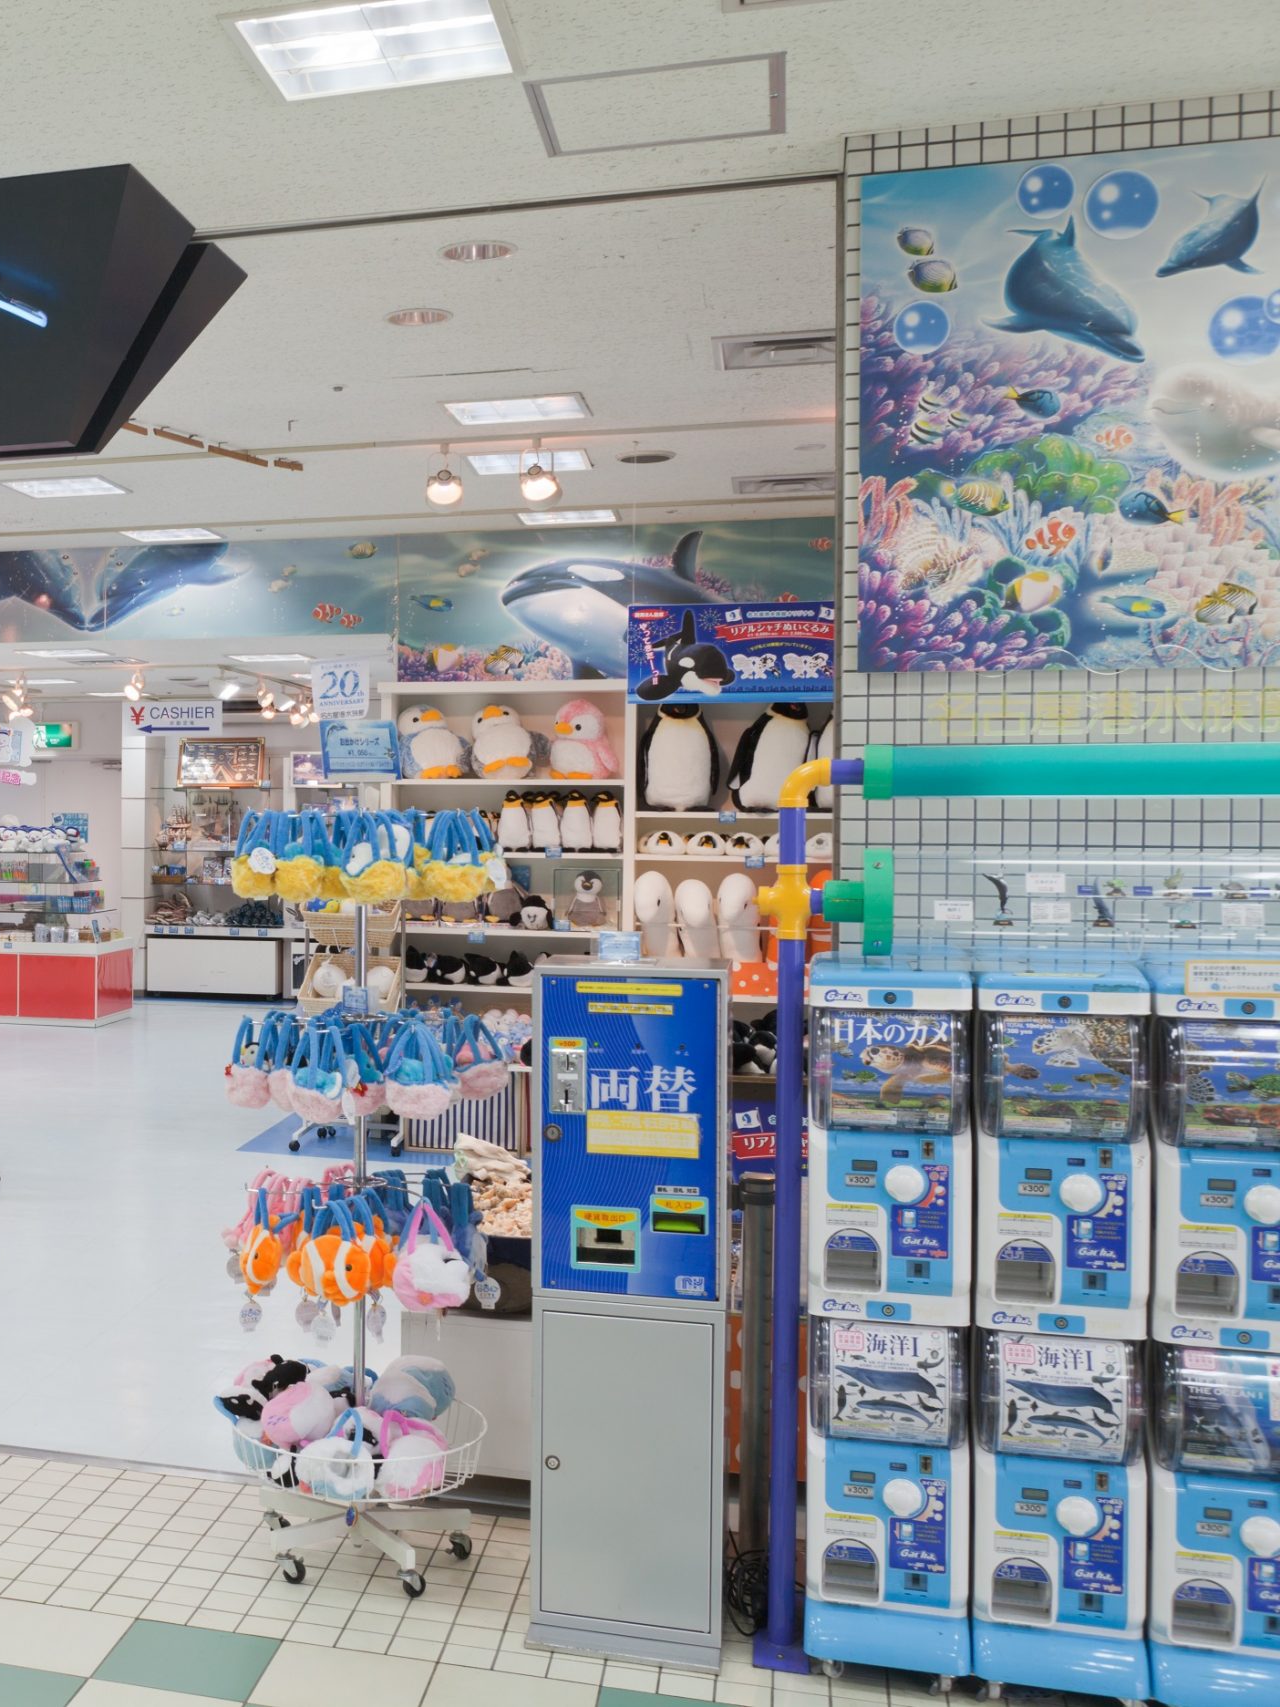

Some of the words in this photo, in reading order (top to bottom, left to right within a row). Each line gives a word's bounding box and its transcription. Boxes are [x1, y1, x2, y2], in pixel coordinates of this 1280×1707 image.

[319, 698, 365, 707] ANNIVERSARY
[150, 706, 215, 720] CASHIER
[834, 1019, 949, 1047] 日本のカメ
[588, 1065, 697, 1113] 両替
[1188, 1385, 1211, 1395] THE
[1215, 1386, 1256, 1399] OCEAN
